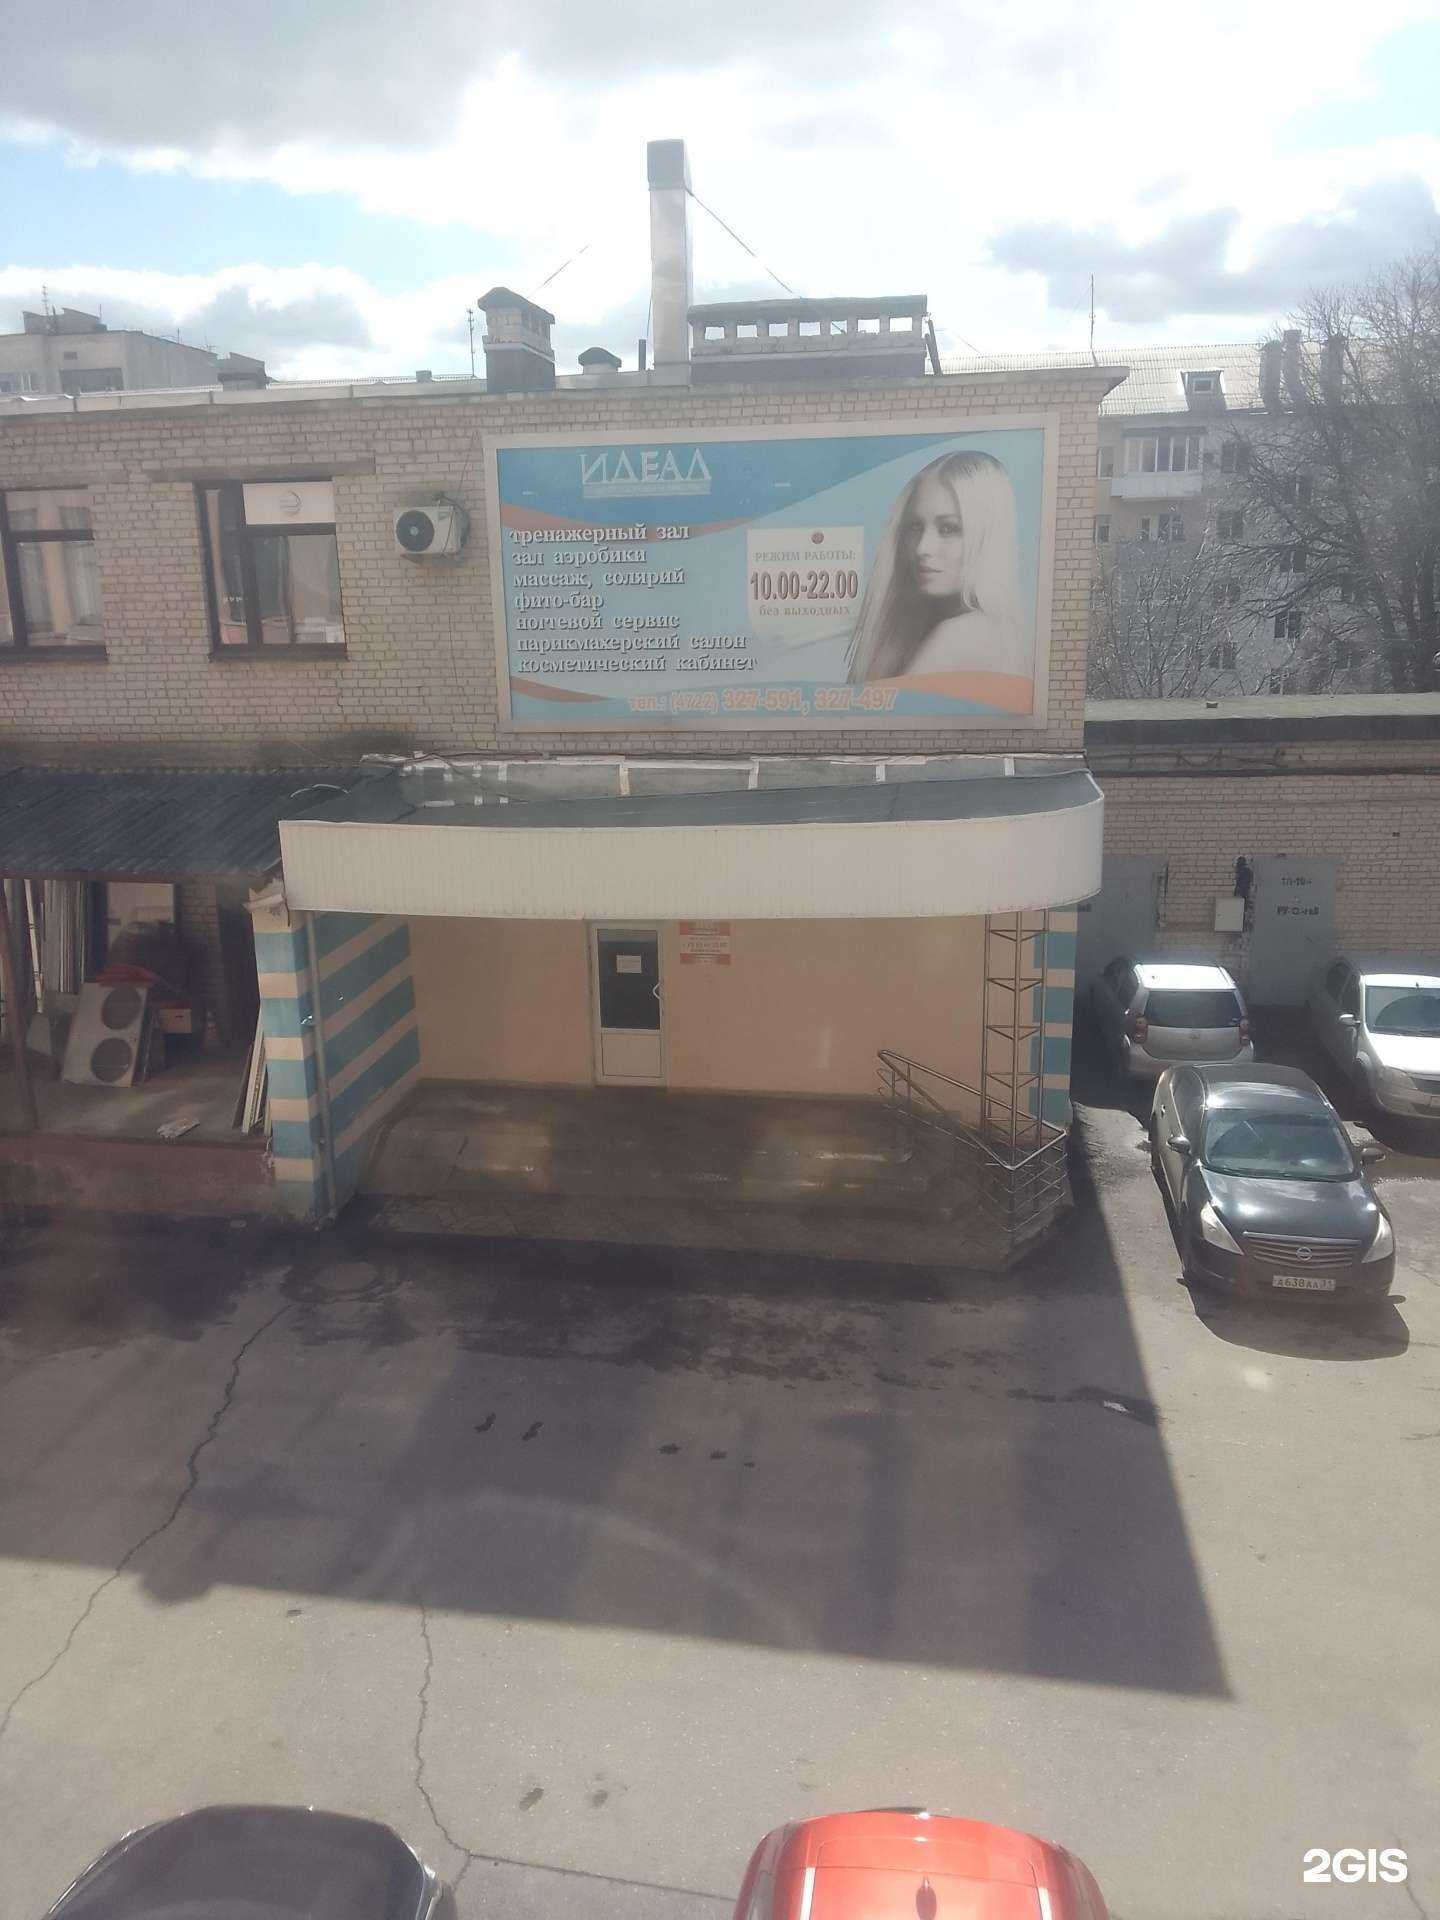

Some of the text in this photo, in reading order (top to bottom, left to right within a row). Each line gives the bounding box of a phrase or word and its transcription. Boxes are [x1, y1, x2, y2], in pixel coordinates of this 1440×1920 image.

[580, 448, 712, 485] ИДЕАЛ
[509, 522, 689, 545] тренажерный зал
[512, 546, 647, 568] зал аэробики
[512, 567, 686, 590] массаж, солярий
[750, 569, 859, 600] 10.00-22.00
[514, 590, 604, 612] фито-бар
[784, 605, 850, 617] выходных
[516, 611, 680, 633] ногтевой сервис
[517, 633, 748, 655] парикмахерский салон
[517, 653, 758, 674] косметический кабинет
